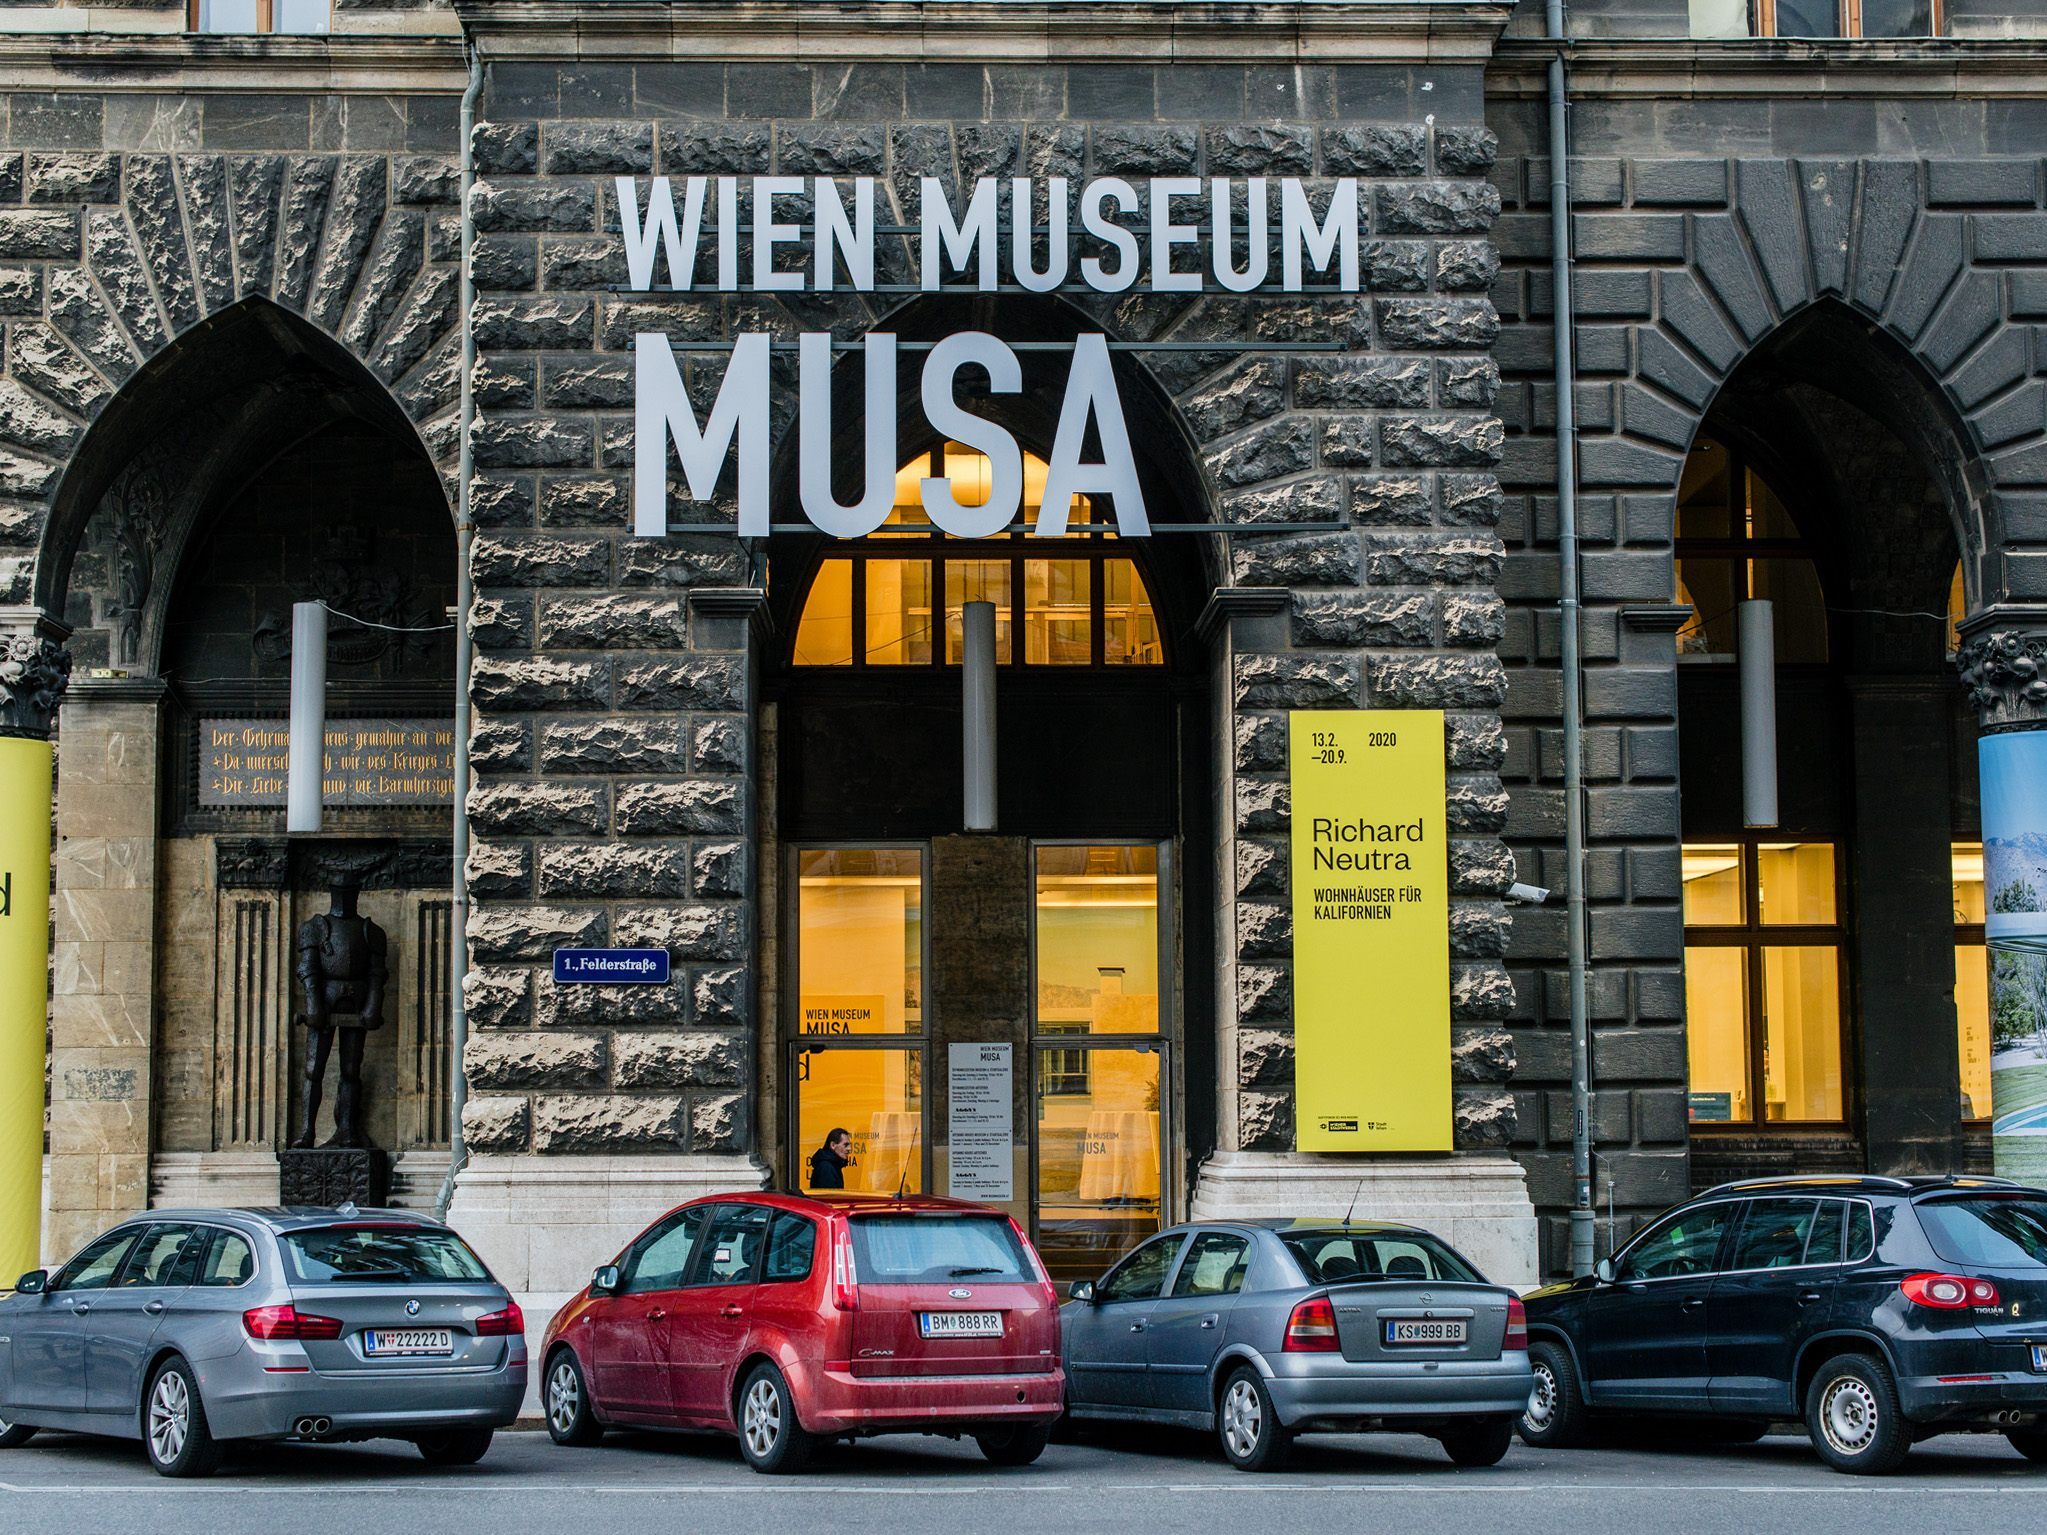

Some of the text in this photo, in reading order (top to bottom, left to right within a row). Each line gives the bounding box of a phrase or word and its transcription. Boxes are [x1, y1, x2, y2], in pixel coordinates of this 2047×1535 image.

[615, 176, 1359, 293] WIEN MUSEUM
[635, 331, 1153, 540] MUSA
[1312, 732, 1397, 747] 13.2. 2020
[1313, 818, 1424, 842] Richard
[1313, 846, 1411, 871] Neutra
[1314, 885, 1422, 903] WOHNHÄUSER FÜR
[1314, 905, 1392, 920] KALIFORNIEN
[806, 1009, 871, 1020] WIEN MUSEUM
[980, 1053, 1001, 1061] MUSA
[932, 1315, 950, 1330] BM
[958, 1315, 981, 1330] 888
[983, 1315, 999, 1329] RR
[1398, 1324, 1413, 1338] KS
[1421, 1324, 1443, 1338] 999
[1446, 1324, 1461, 1338] BB
[376, 1333, 386, 1347] W
[396, 1332, 438, 1347] 22222
[440, 1332, 449, 1346] D
